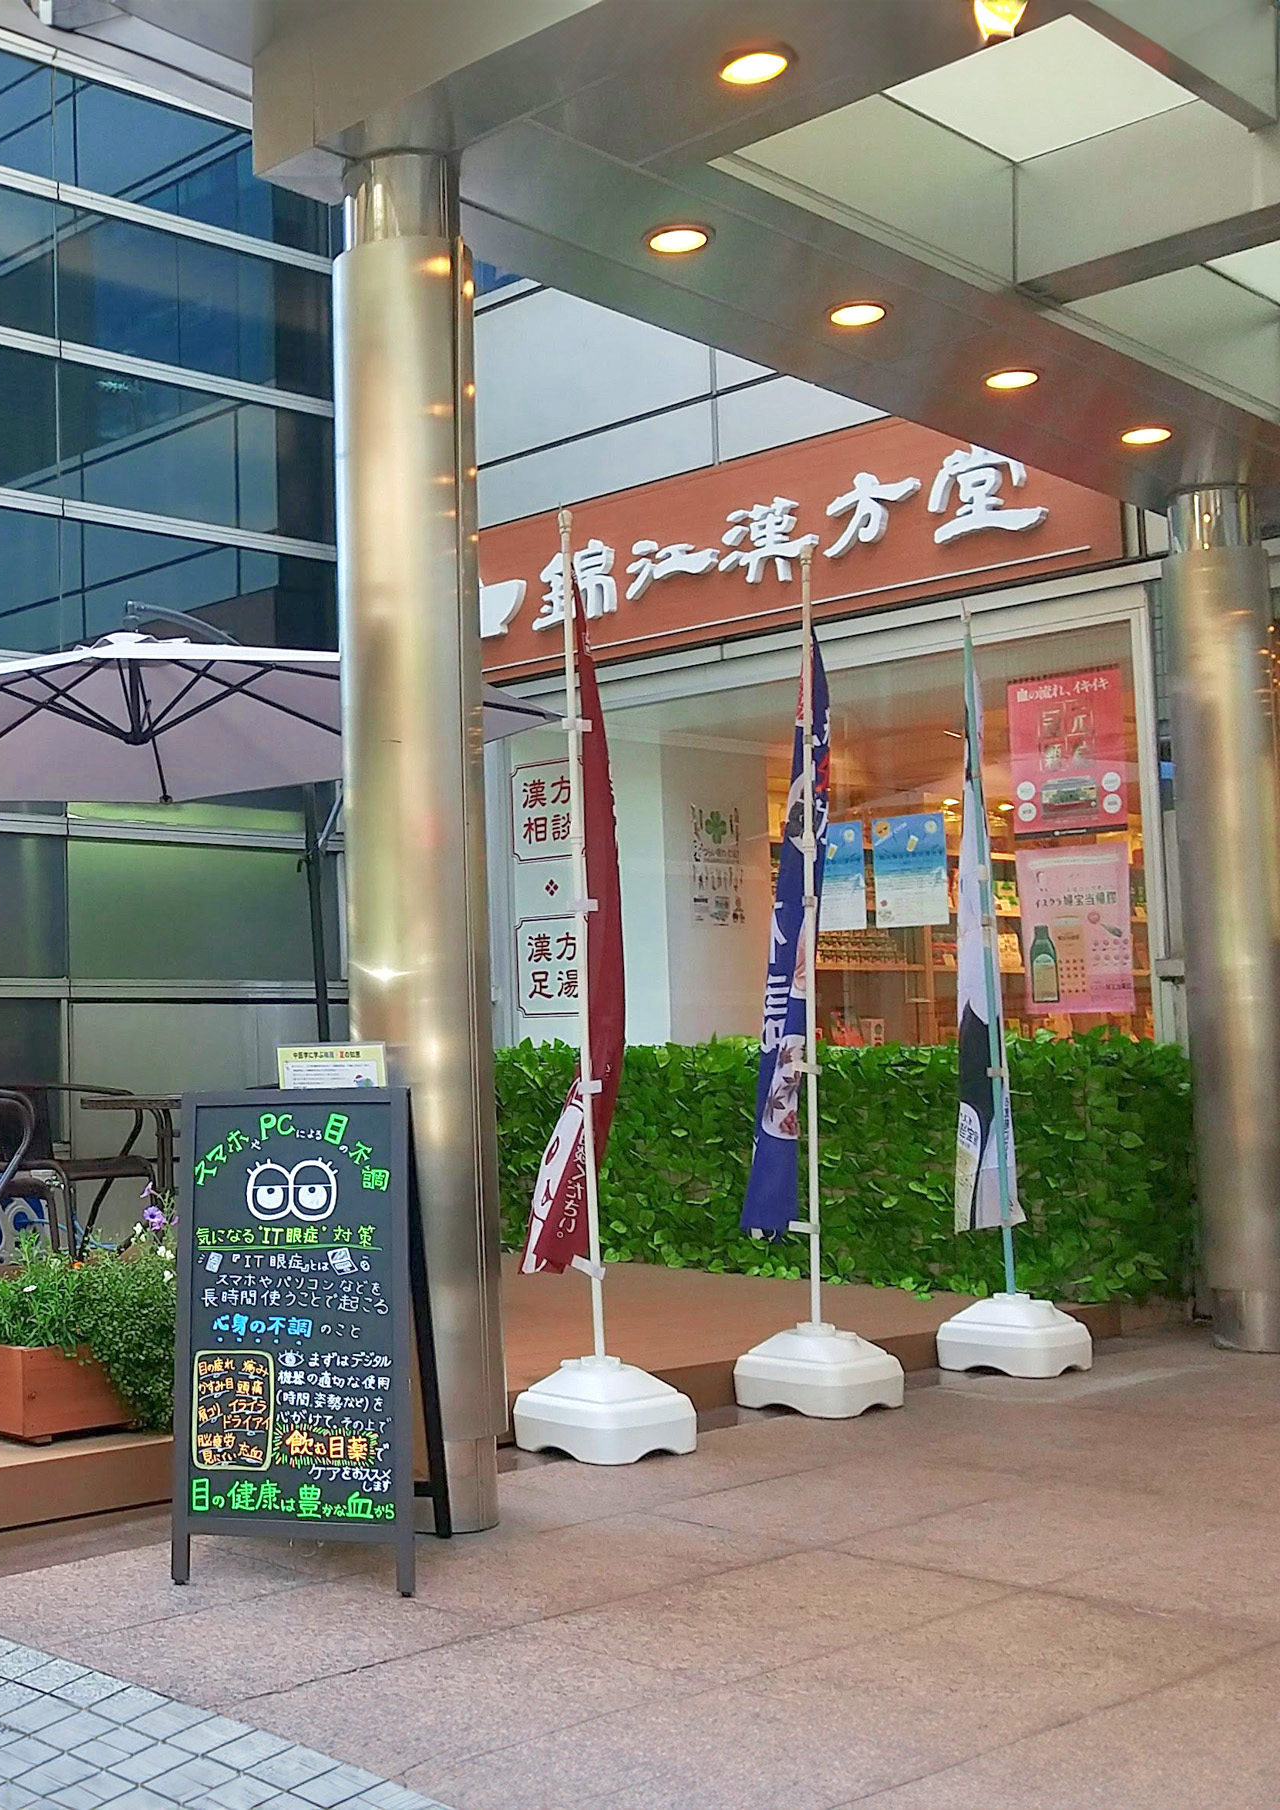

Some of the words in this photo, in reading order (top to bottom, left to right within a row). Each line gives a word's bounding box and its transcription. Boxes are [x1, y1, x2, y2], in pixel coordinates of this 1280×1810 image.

[532, 443, 1049, 632] 錦江漢方堂
[522, 775, 571, 809] 漢方
[522, 812, 572, 845] 相談
[527, 931, 577, 963] 漢方
[528, 969, 579, 1000] 足湯
[216, 1273, 382, 1297] スマホやパソコンなどを
[201, 1287, 390, 1315] 長時間使うことで起こる
[308, 1352, 392, 1368] まずはデジタル
[236, 1380, 264, 1395] 頭痛
[277, 1370, 391, 1391] 機器の適切な使用
[228, 1399, 267, 1413] イライラ
[223, 1414, 271, 1431] ドライアイ
[308, 1464, 392, 1481] ケアをおススメ
[192, 1477, 396, 1520] 目の健康は豊かな血から
[362, 1481, 392, 1493] します
